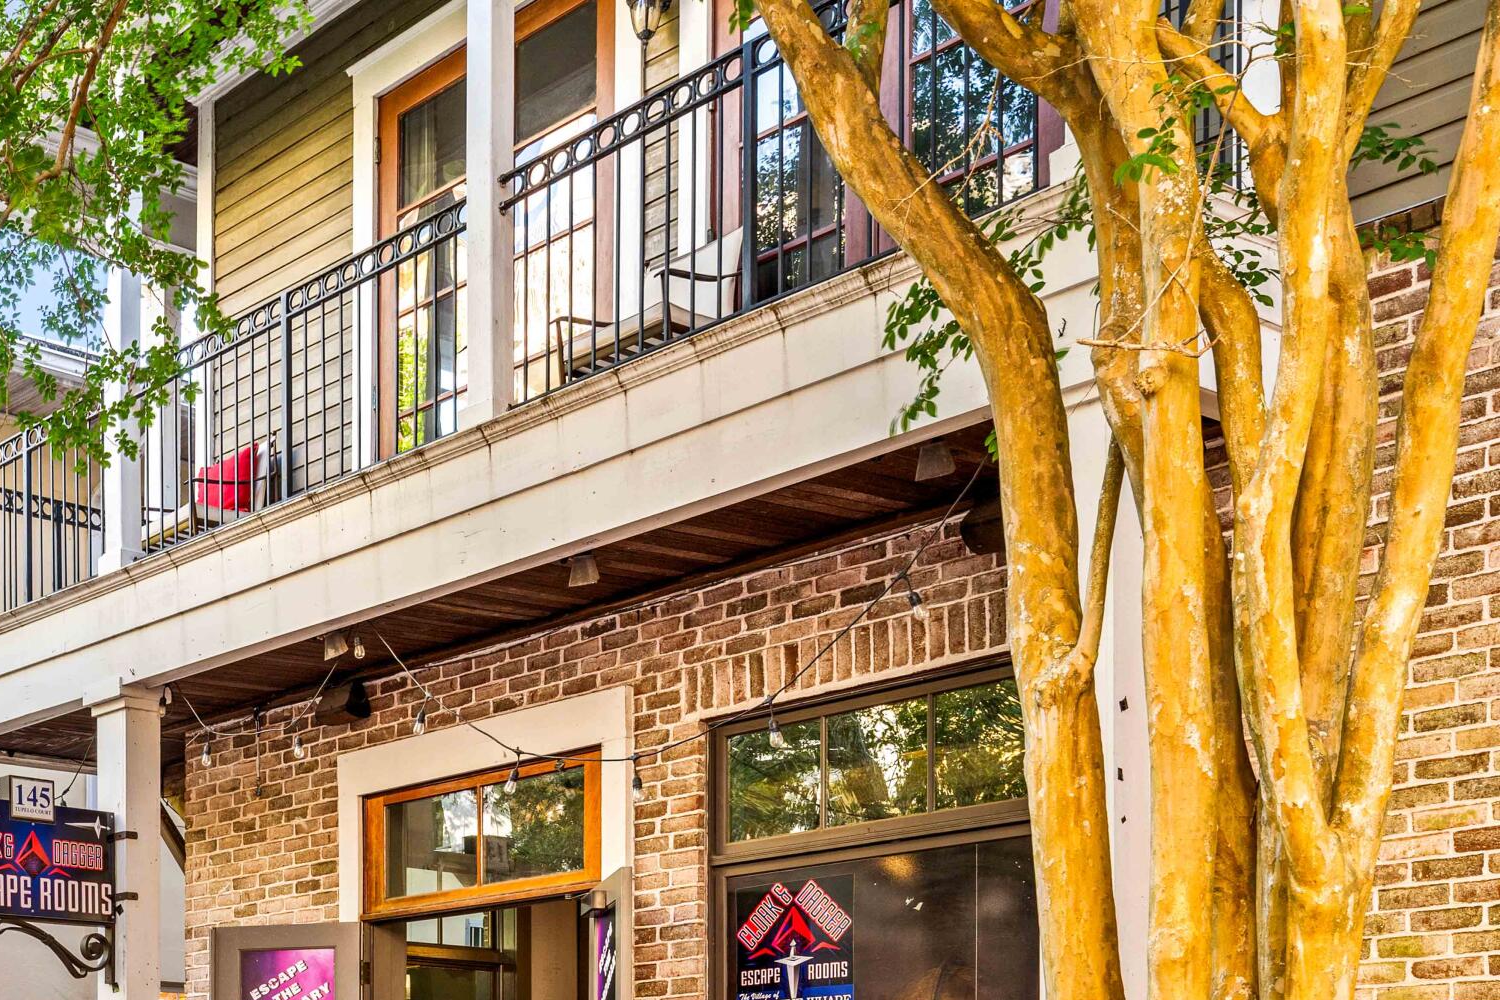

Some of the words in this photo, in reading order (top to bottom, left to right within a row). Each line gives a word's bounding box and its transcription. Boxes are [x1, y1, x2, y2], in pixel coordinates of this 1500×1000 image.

[15, 784, 50, 808] 145
[3, 833, 14, 859] &
[52, 839, 103, 871] DAGGER
[40, 877, 112, 915] ROOMS
[737, 894, 784, 951] CLOAK
[794, 879, 852, 942] DAGGER
[249, 960, 308, 1000] ESCAPE
[741, 967, 780, 986] ESCAPE
[808, 961, 848, 980] ROOMS
[773, 991, 780, 999] of
